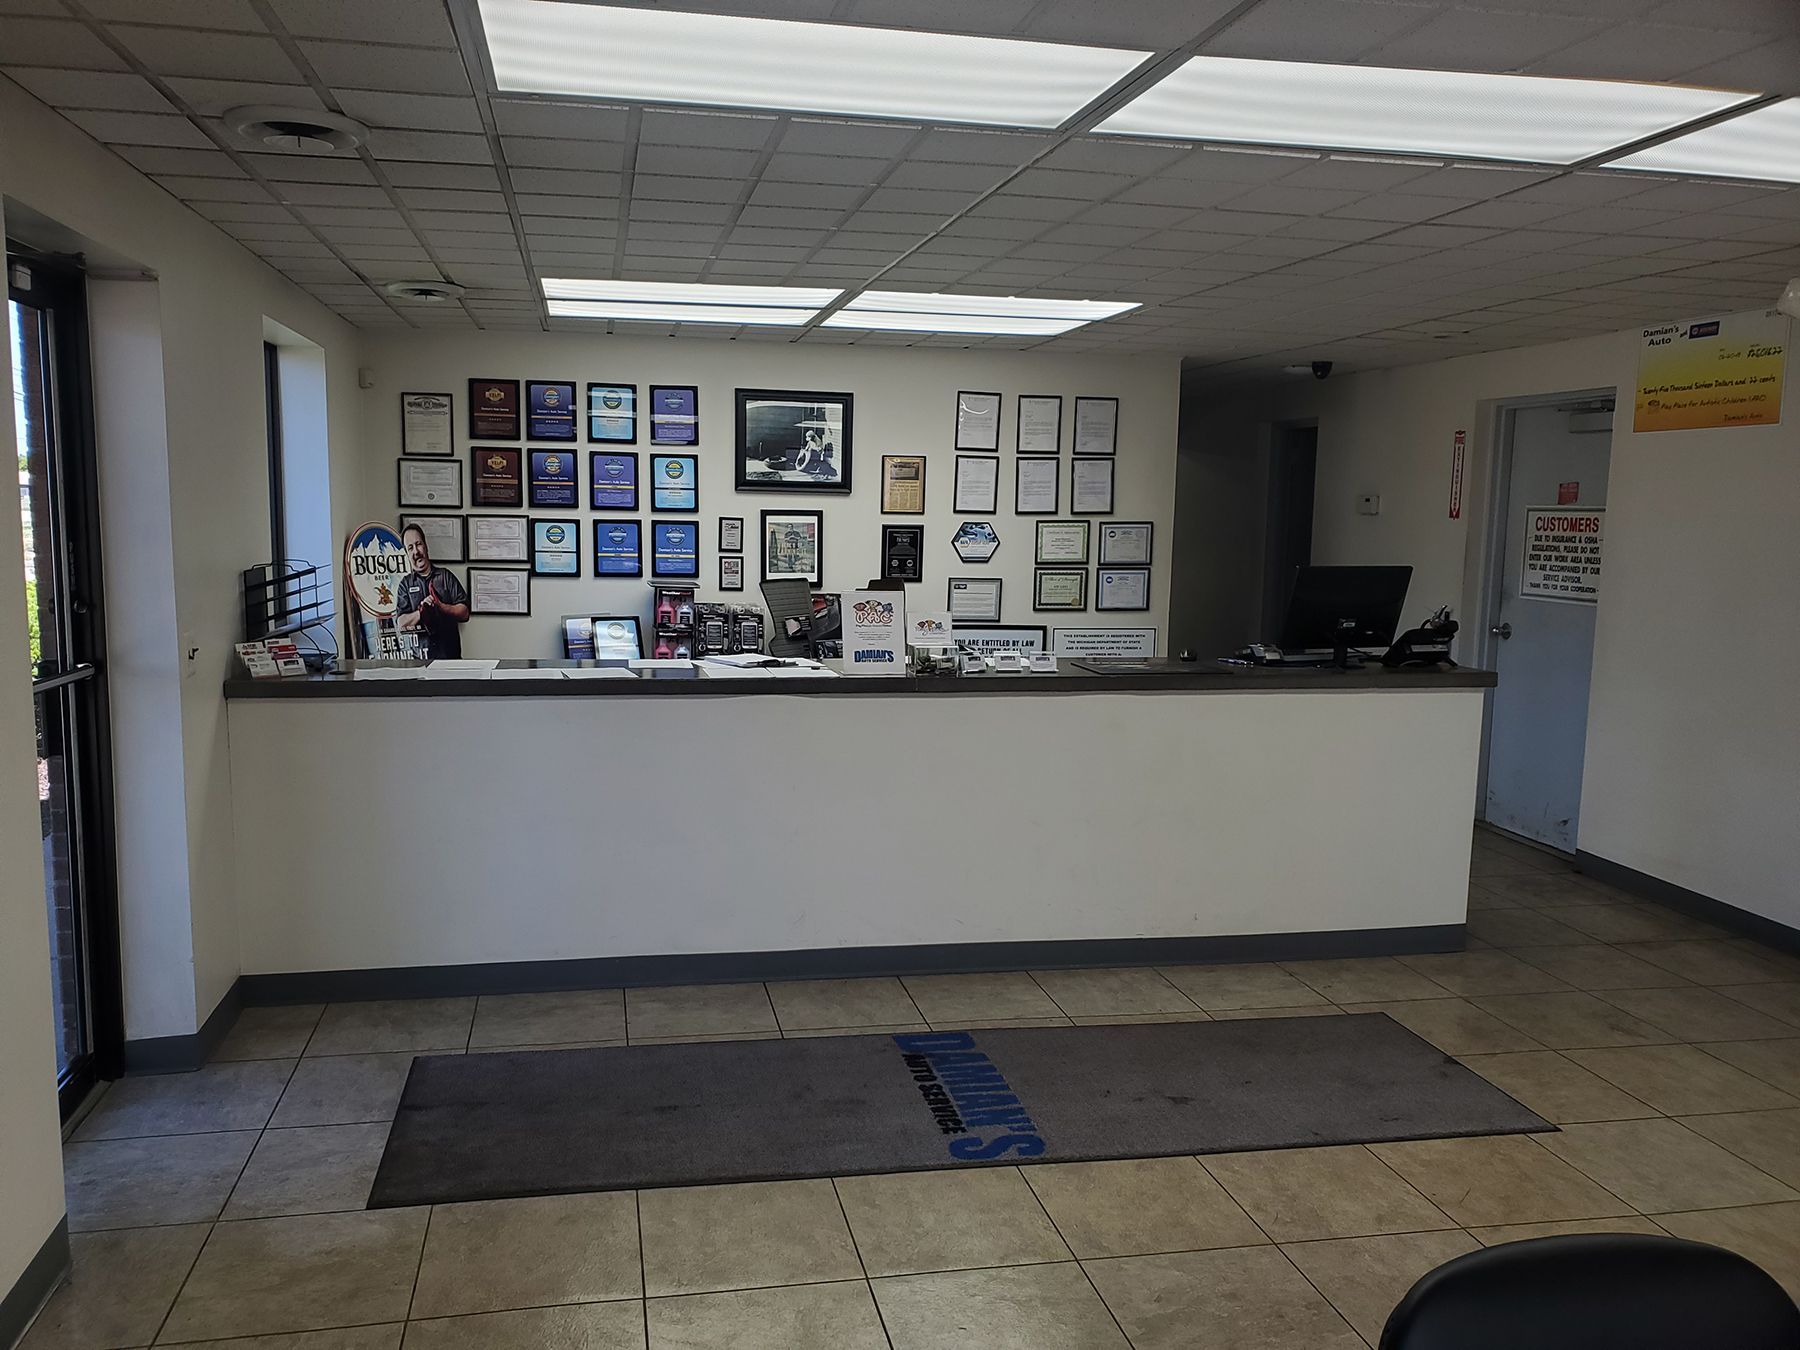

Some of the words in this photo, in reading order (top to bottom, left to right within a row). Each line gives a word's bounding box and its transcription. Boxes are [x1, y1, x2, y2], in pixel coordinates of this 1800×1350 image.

[1643, 325, 1680, 338] Damian's
[1648, 337, 1672, 347] Auto
[1735, 377, 1746, 386] and
[1536, 516, 1600, 533] CUSTOMERS
[352, 554, 407, 576] BUSCH
[1571, 556, 1583, 564] AREA
[1584, 557, 1601, 565] UNLESS
[1549, 565, 1580, 573] ACCOMPANIED
[1590, 567, 1600, 575] OUR
[1543, 574, 1559, 582] SERVICE
[408, 633, 419, 648] TO
[967, 639, 979, 647] ARE
[419, 647, 429, 660] IT
[854, 649, 895, 663] DAMIAN'S
[891, 1032, 1047, 1160] DAMIAN'S
